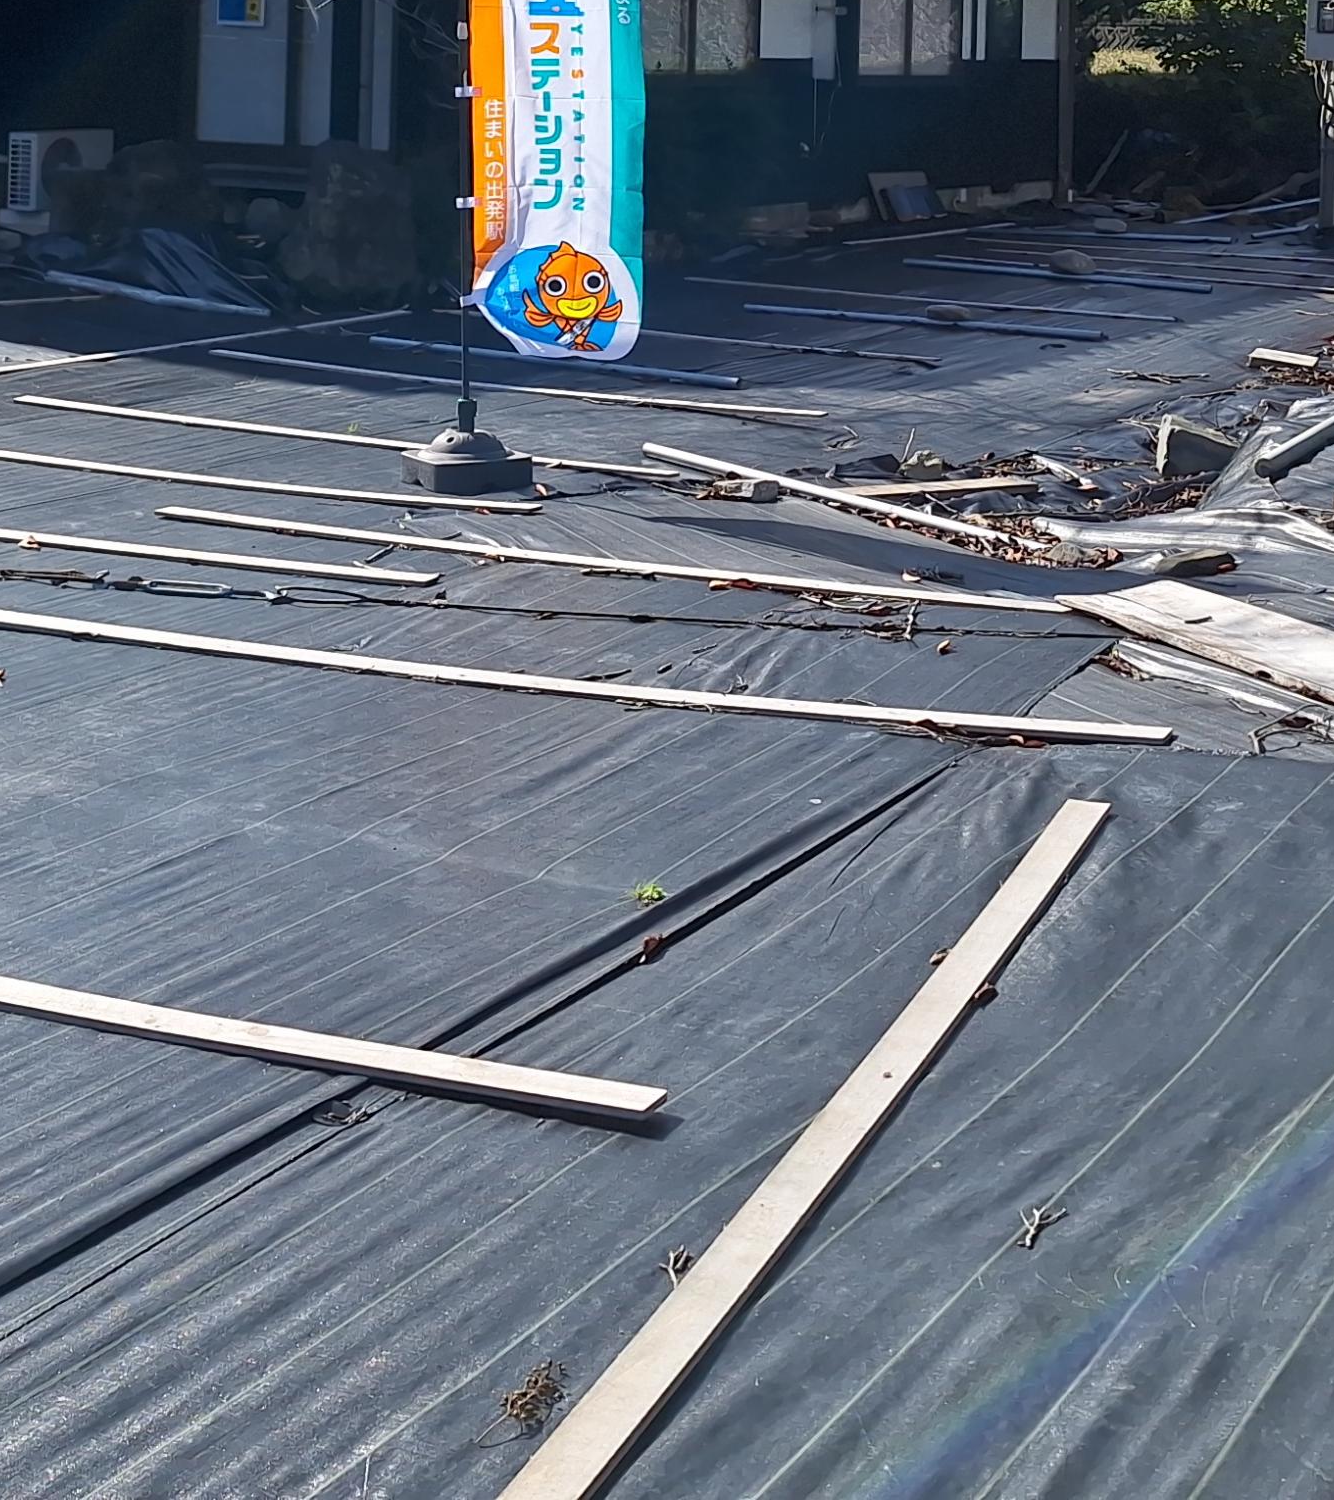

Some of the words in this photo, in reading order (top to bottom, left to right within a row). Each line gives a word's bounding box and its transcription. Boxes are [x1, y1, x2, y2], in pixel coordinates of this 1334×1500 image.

[483, 98, 506, 241] 住まいの出発駅
